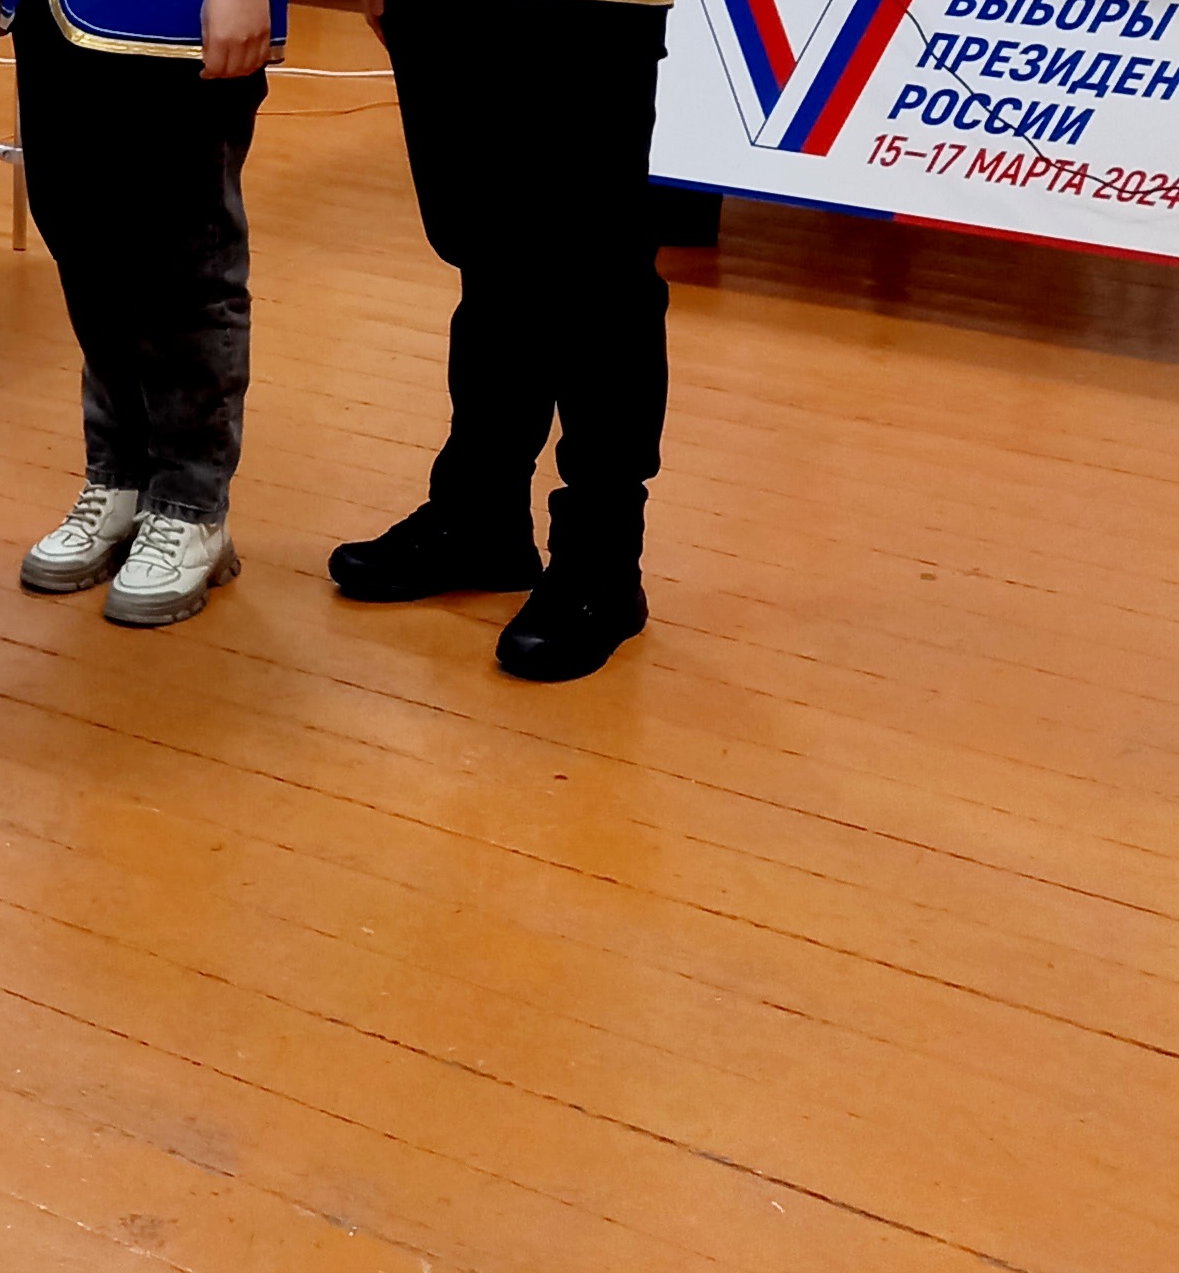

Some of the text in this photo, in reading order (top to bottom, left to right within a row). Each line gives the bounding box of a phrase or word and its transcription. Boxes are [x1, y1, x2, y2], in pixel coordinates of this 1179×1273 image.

[887, 83, 1096, 146] РОССИИ
[964, 148, 1090, 196] МАРТА
[1091, 167, 1179, 210] 2024
